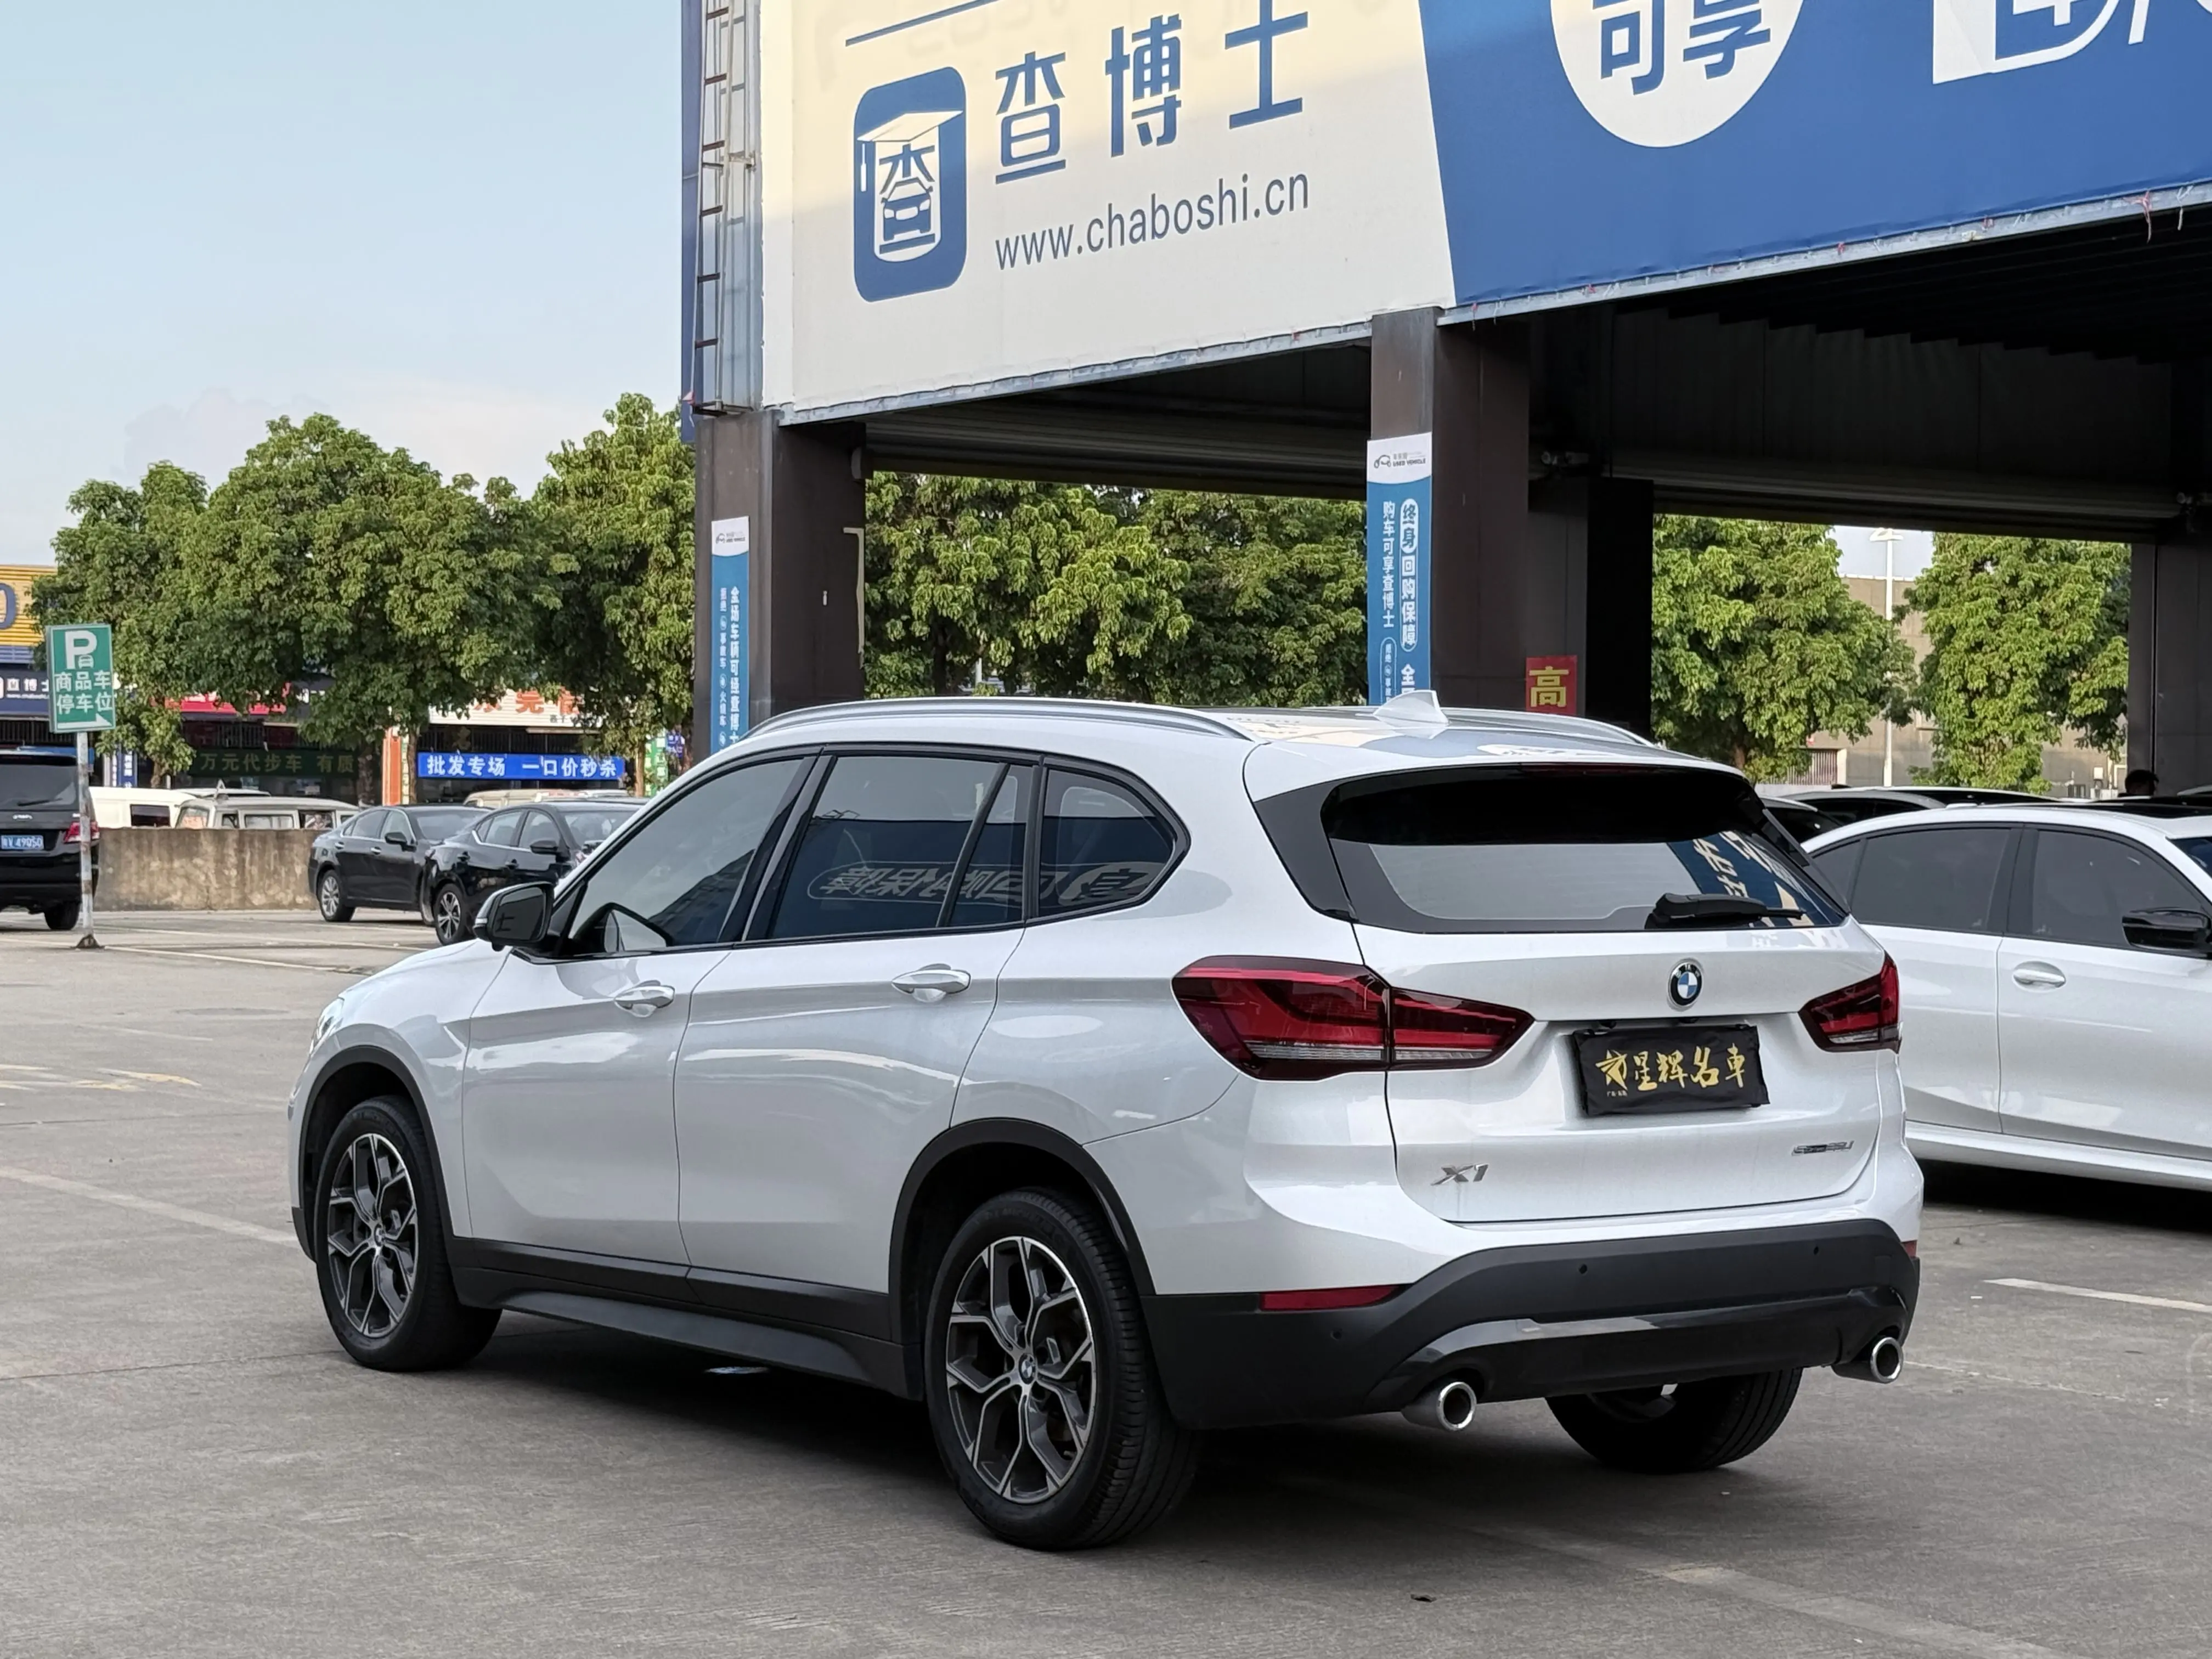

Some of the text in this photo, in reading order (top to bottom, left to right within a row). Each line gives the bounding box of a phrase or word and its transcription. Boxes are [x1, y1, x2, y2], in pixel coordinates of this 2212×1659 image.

[996, 0, 1308, 184] 查博士
[995, 173, 1308, 270] www.chaboshi.cn
[1383, 500, 1396, 628] 购车可享查博士
[1402, 504, 1417, 646] 终身回购保障
[65, 630, 97, 670] P
[54, 670, 111, 692] 商品车
[1529, 665, 1570, 707] 高
[56, 691, 113, 715] 停车位
[200, 753, 302, 772] 万元代步车
[427, 755, 617, 777] 批发专场 一口价秒杀
[1430, 1163, 1489, 1186] X1
